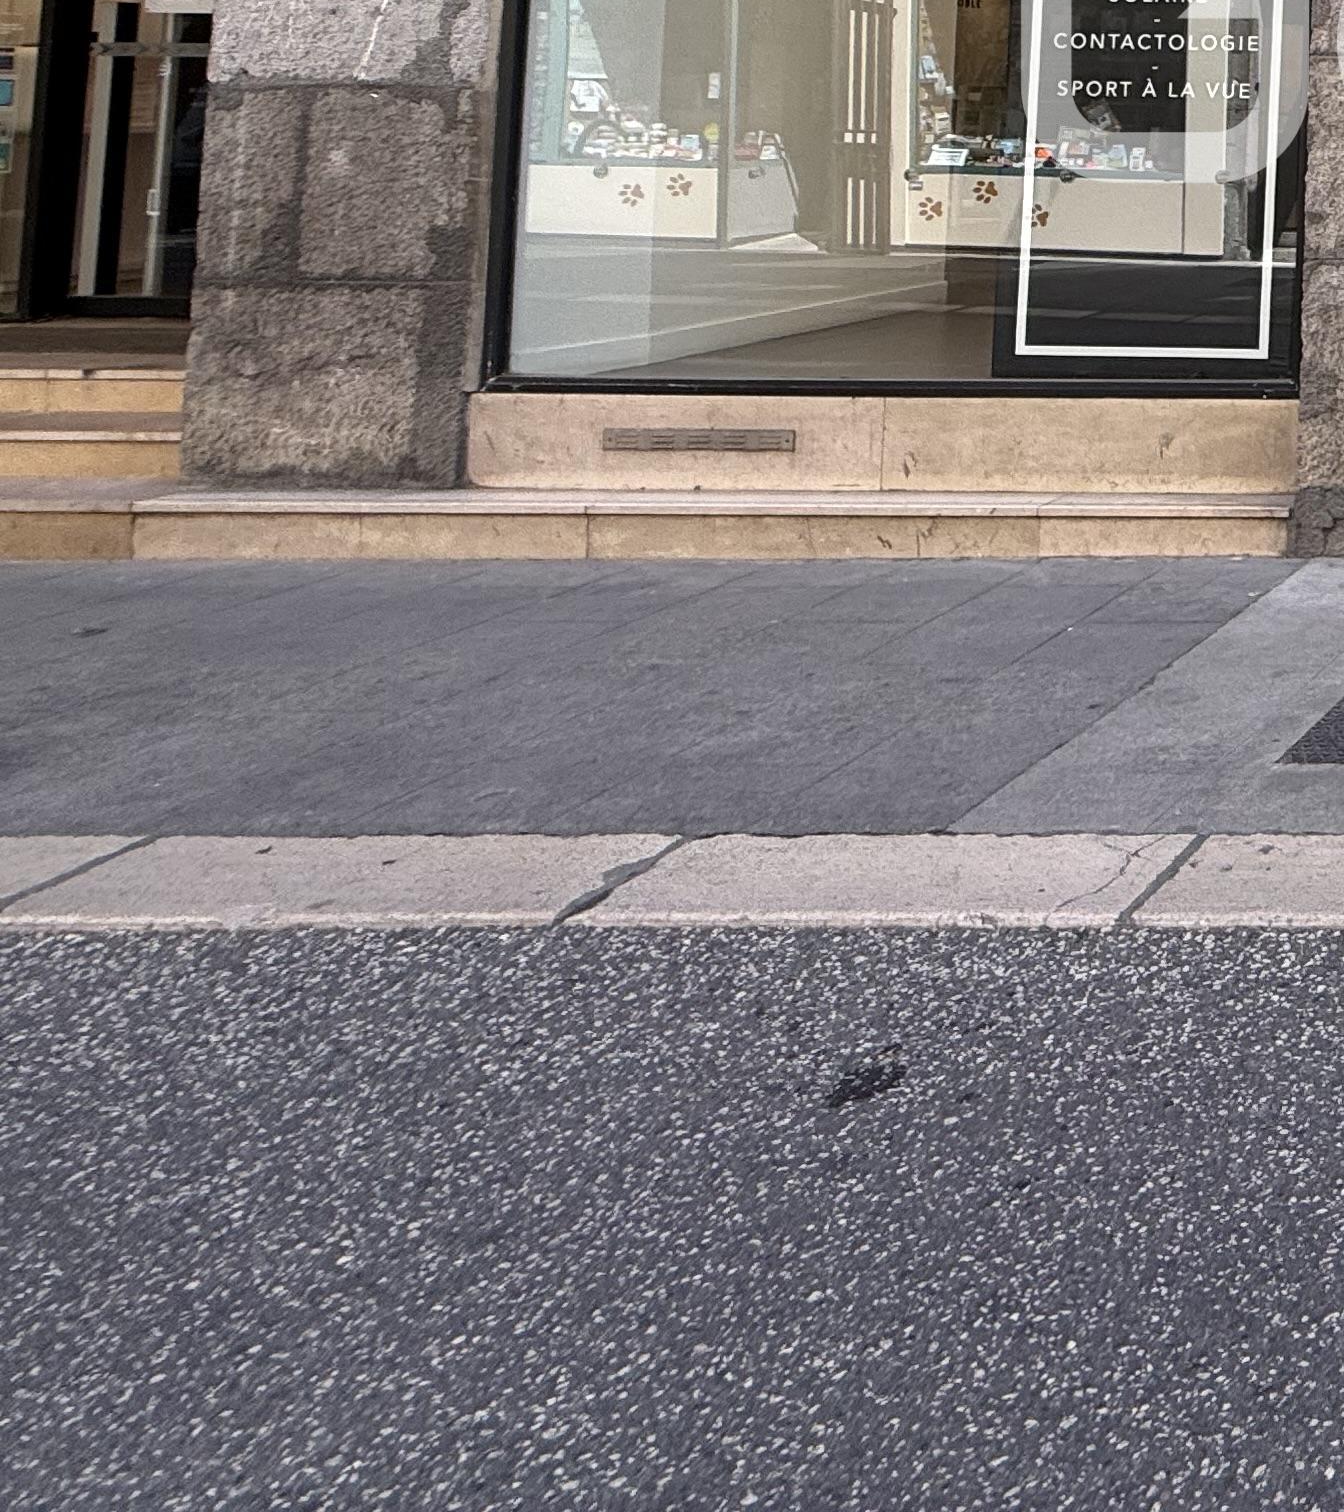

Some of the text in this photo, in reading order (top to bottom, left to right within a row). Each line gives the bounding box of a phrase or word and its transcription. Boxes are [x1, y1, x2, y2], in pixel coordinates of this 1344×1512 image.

[1053, 33, 1259, 52] CONTACTOLOGIE
[1056, 78, 1251, 99] SPORT À LA VUE
